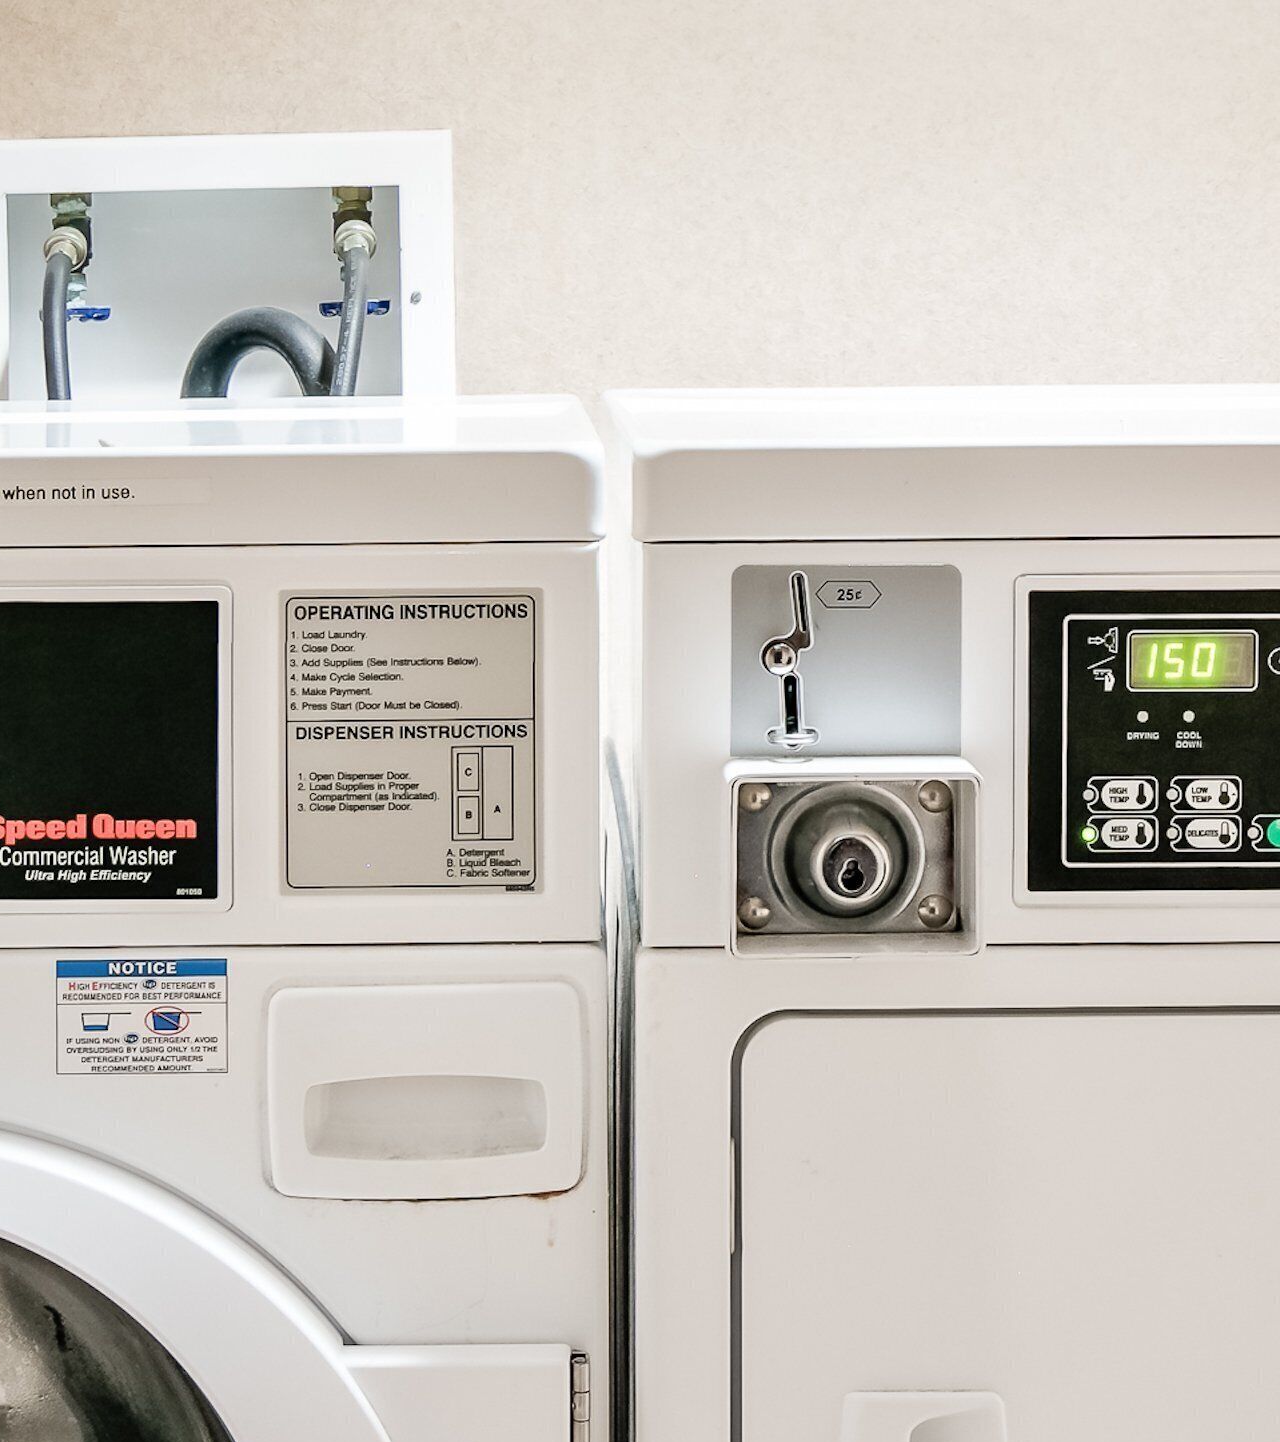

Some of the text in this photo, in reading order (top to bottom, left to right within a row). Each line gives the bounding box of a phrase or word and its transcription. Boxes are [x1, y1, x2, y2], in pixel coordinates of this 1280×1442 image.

[3, 486, 45, 500] when
[52, 487, 76, 499] not
[82, 485, 95, 499] in
[102, 488, 135, 499] use.
[295, 603, 527, 620] OPERATING INSTRUCTIONS
[302, 631, 325, 639] Load
[301, 643, 328, 653] Close
[302, 659, 320, 667] Add
[323, 658, 363, 668] Supplies
[367, 658, 387, 667] (See
[391, 658, 444, 666] Instructions
[1147, 643, 1216, 679] 150
[302, 673, 326, 681] Make
[330, 673, 355, 683] Cycle
[302, 702, 328, 710] Press
[331, 702, 352, 710] Start
[355, 701, 381, 711] (Door
[384, 701, 406, 710] Must
[296, 724, 527, 740] DISPENSER INSTRUCTIONS
[309, 772, 334, 782] Open
[338, 772, 384, 782] Dispenser
[464, 768, 472, 777] C
[310, 782, 419, 793] Load Supplies Proper
[310, 793, 371, 802] Compartment
[310, 803, 336, 811] Close
[339, 802, 385, 813] Dispenser
[494, 805, 501, 814] A
[465, 811, 472, 819] B
[92, 814, 197, 839] Queen
[109, 846, 177, 866] Washer
[459, 848, 505, 858] Detergent
[459, 858, 521, 868] Liquid Bleach
[25, 869, 151, 883] Ultra High Efficiency
[460, 869, 530, 877] Fabric Softener
[108, 962, 177, 975] NOTICE
